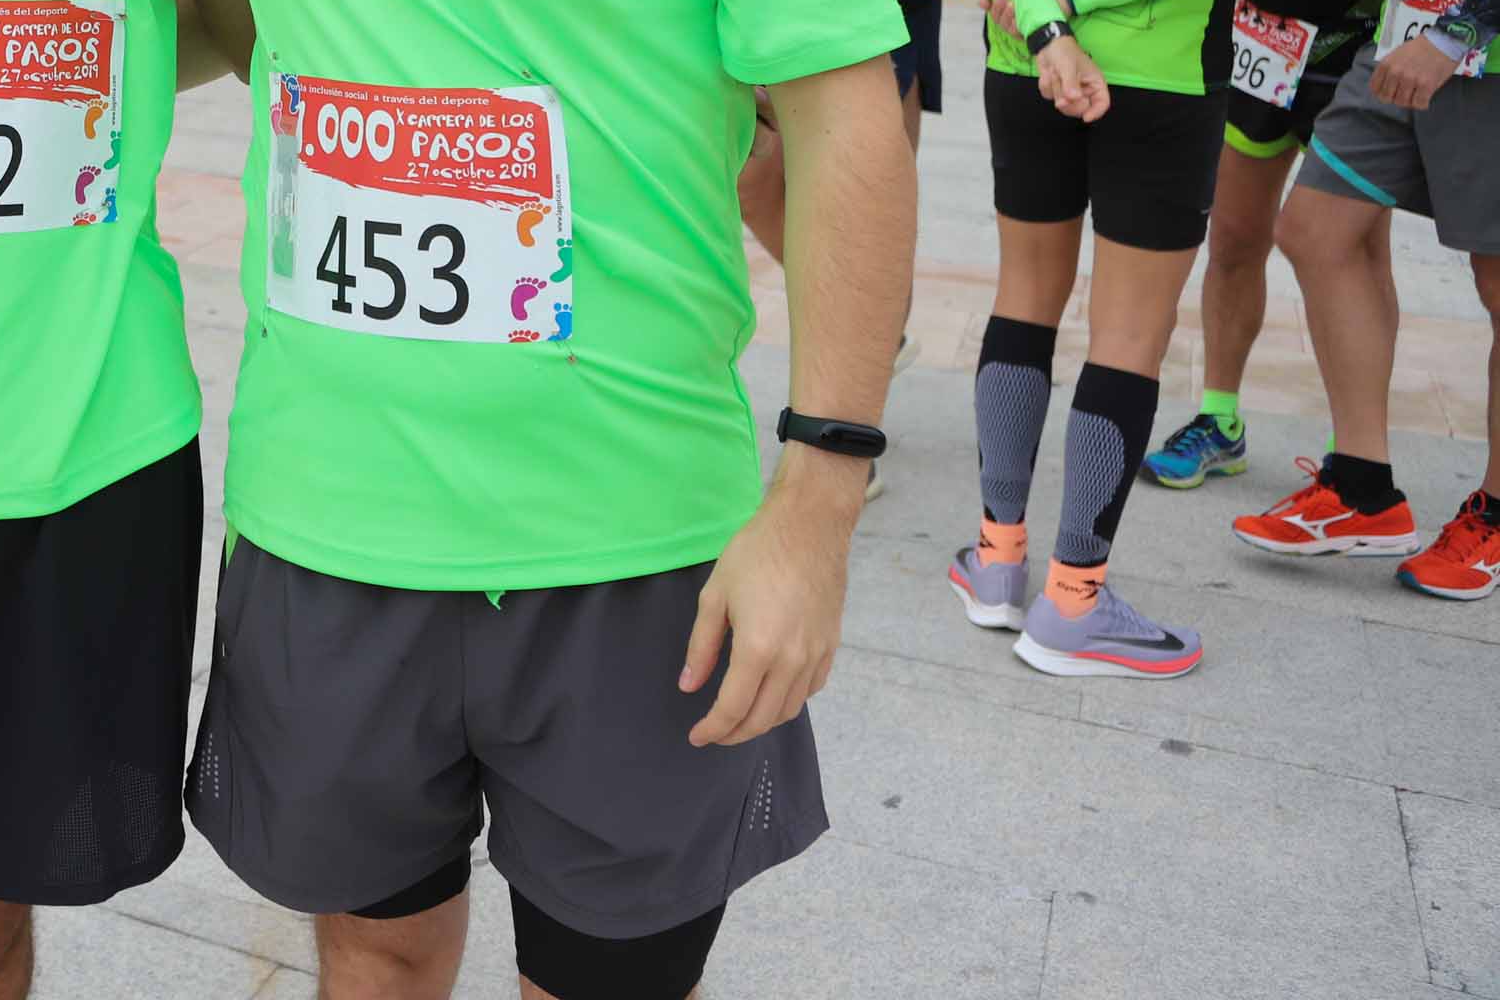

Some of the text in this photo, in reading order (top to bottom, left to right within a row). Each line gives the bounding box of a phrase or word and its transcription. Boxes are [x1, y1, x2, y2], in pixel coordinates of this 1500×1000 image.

[13, 7, 31, 16] del
[33, 6, 69, 17] deporte
[61, 22, 72, 34] DE
[75, 21, 100, 35] LOS
[5, 37, 100, 68] PASOS
[0, 64, 99, 84] 27 octubre 2019
[308, 85, 343, 98] inclusión
[344, 90, 369, 101] social
[382, 94, 415, 105] través
[418, 95, 438, 105] del
[441, 95, 490, 108] deporte
[396, 108, 405, 126] X
[479, 114, 496, 128] DE
[501, 113, 535, 129] LOS
[296, 100, 396, 163] 1.000
[411, 130, 536, 163] PASOS
[406, 162, 537, 180] 27 octubre 2019
[316, 215, 470, 326] 453
